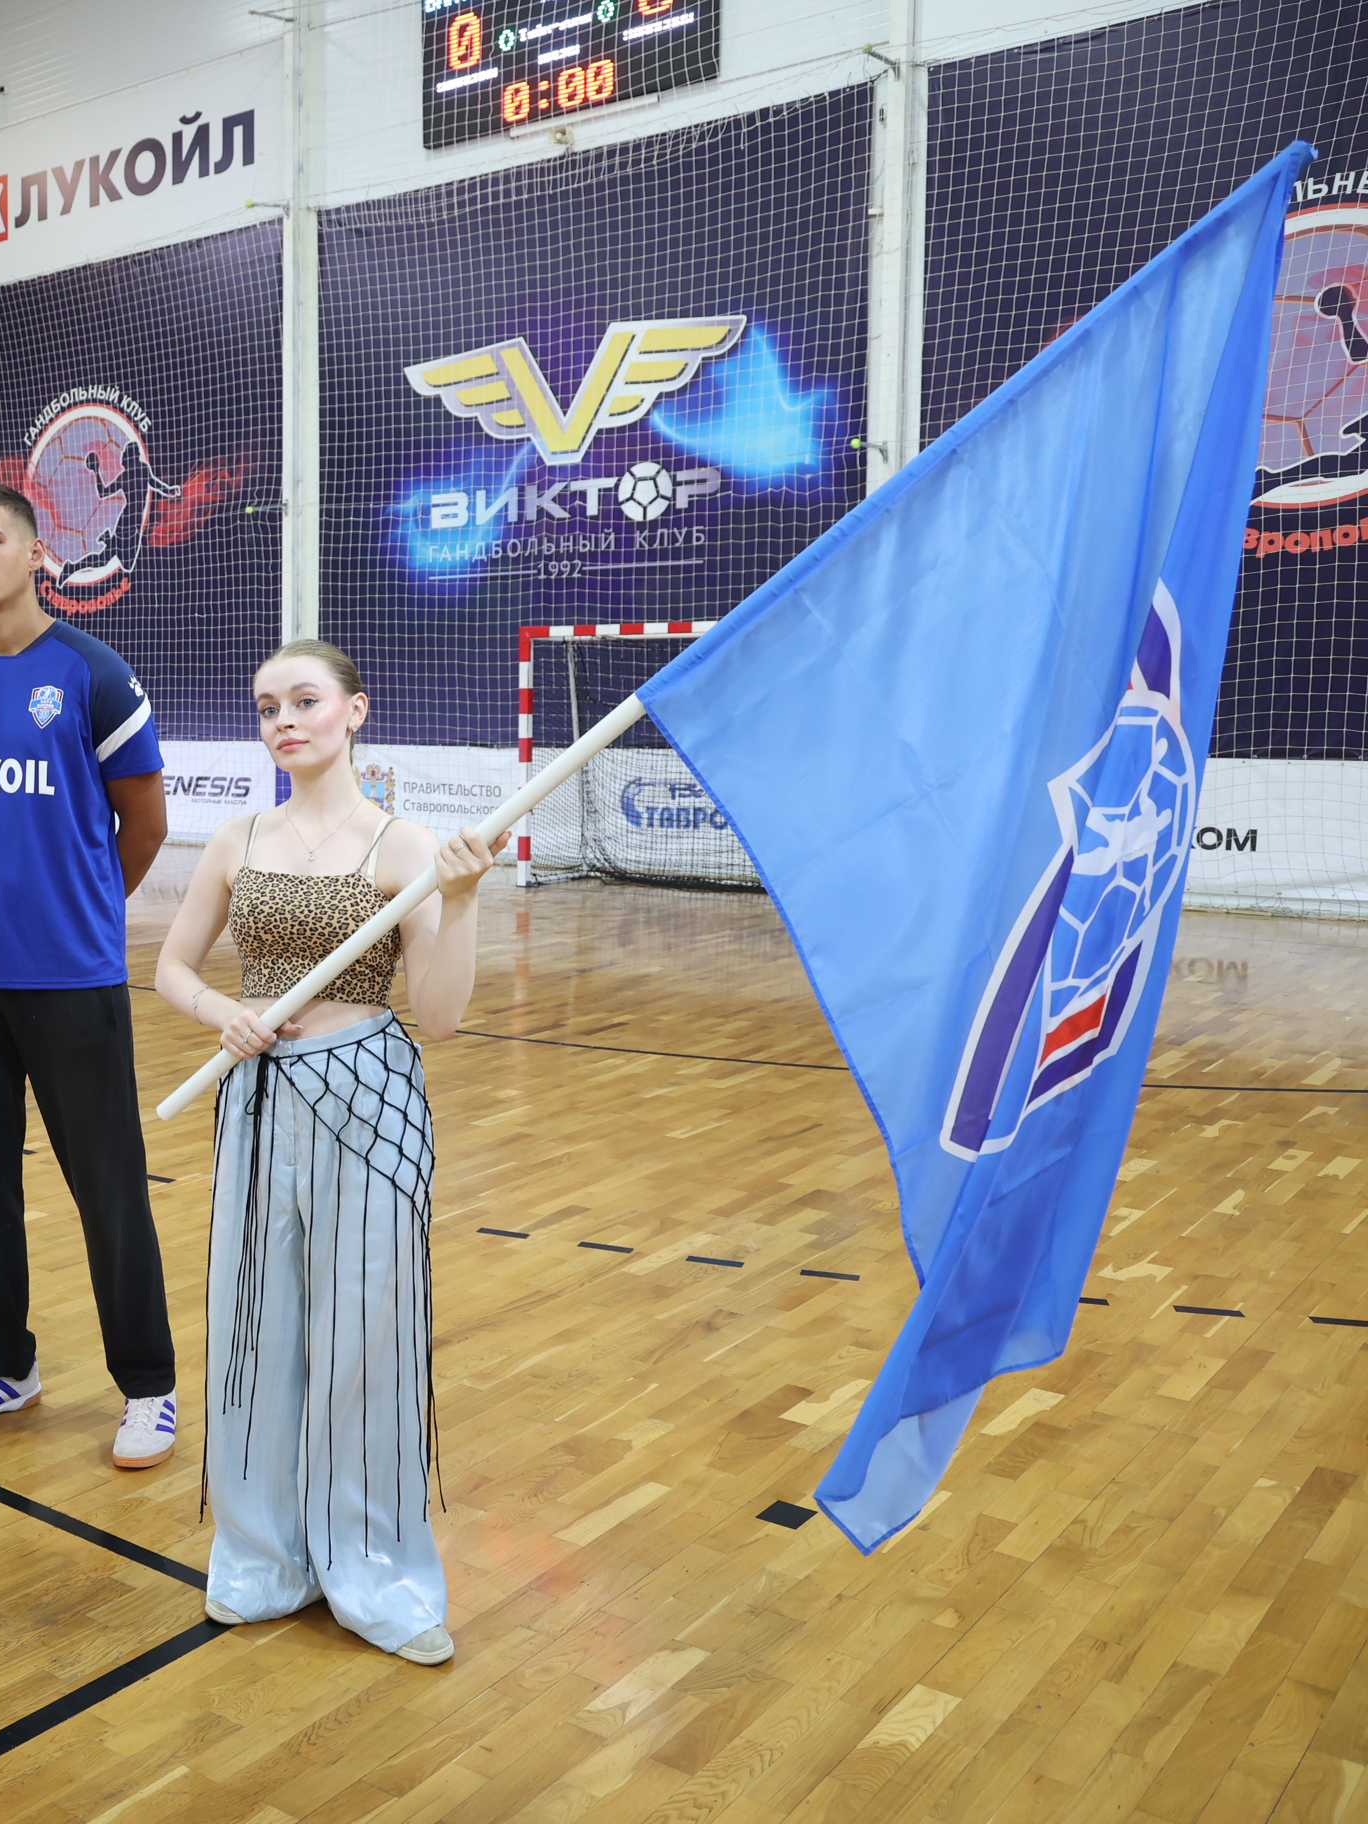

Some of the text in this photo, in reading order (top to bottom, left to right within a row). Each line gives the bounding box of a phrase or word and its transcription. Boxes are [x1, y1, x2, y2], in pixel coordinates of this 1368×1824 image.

[449, 12, 481, 70] 0
[502, 59, 614, 122] 0:00
[14, 108, 255, 229] ЛУКОЙЛ
[24, 384, 152, 446] ГАНДБОЛЬНЫЙ КЛУБ
[431, 462, 722, 529] ВИКТОР
[429, 526, 706, 563] ГАНДБОЛЬНЫЙ КЛУБ
[537, 560, 582, 579] 1992
[40, 577, 132, 616] Ставрополье
[162, 775, 252, 798] ENESIS
[403, 781, 502, 798] ПРАВИТЕЛЬСТВО
[403, 799, 500, 815] Ставропольског
[1191, 826, 1258, 852] ОМ
